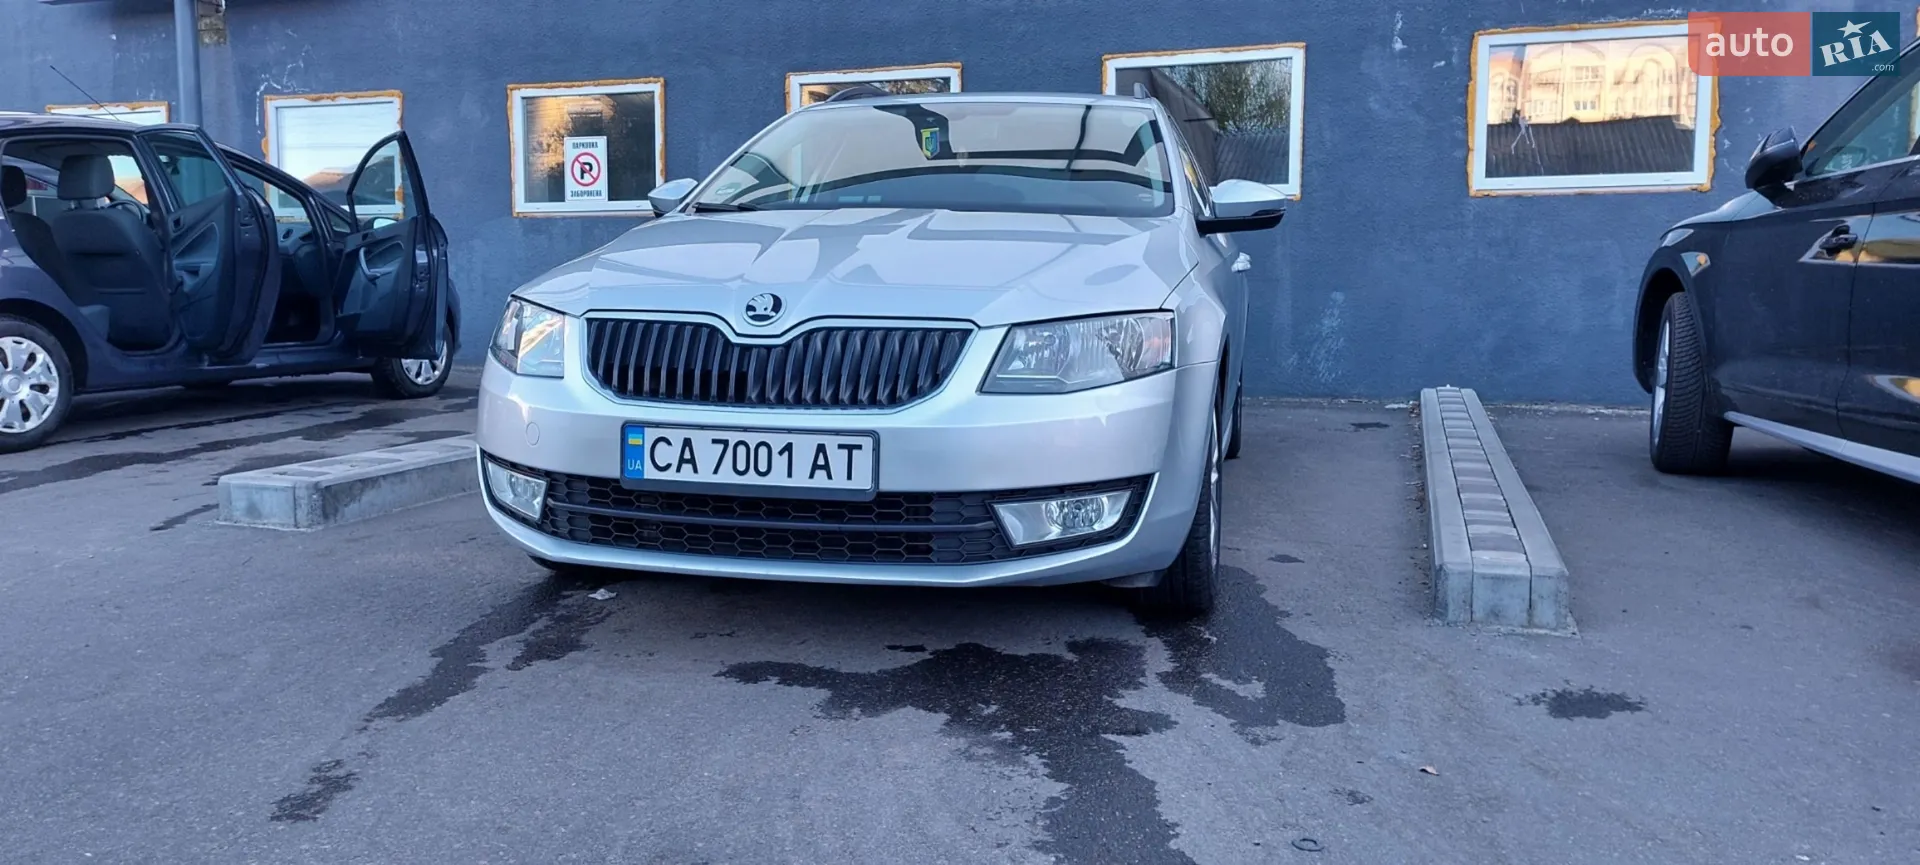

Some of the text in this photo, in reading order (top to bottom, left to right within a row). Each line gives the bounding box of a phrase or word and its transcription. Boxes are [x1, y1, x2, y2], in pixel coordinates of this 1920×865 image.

[570, 189, 602, 198] ЗАБОРОНЕНА
[649, 436, 863, 481] CA 7001 AT
[628, 459, 643, 471] UA
